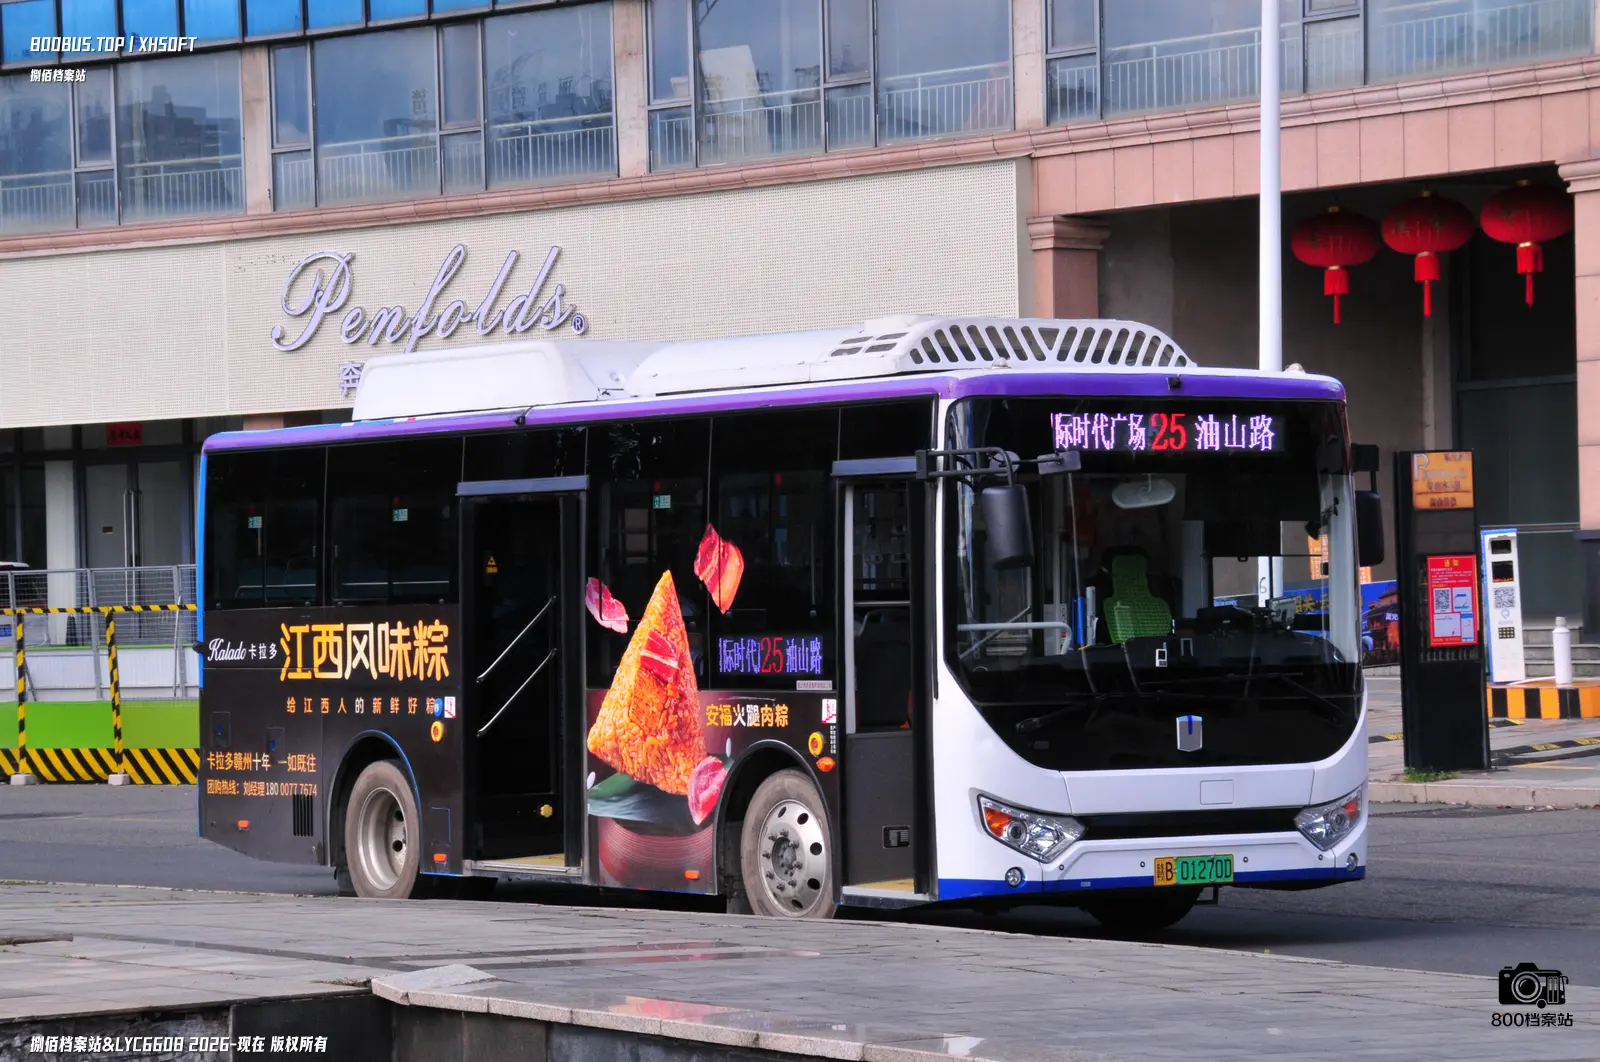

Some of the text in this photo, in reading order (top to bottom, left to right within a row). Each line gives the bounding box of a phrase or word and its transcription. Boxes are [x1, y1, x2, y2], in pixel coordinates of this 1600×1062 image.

[270, 243, 575, 353] Penfolds
[1050, 412, 1276, 450] 际时代广场 25 油山路
[1413, 453, 1429, 481] P
[207, 637, 278, 662] Kalado 卡拉多
[280, 619, 449, 682] 江西风味粽
[718, 636, 822, 674] 际时代 25 油山路
[286, 696, 436, 715] 给江西人的新鲜好粽
[705, 704, 789, 727] 安福火腿肉粽
[207, 751, 317, 772] 卡拉多赣州十年 一如既往
